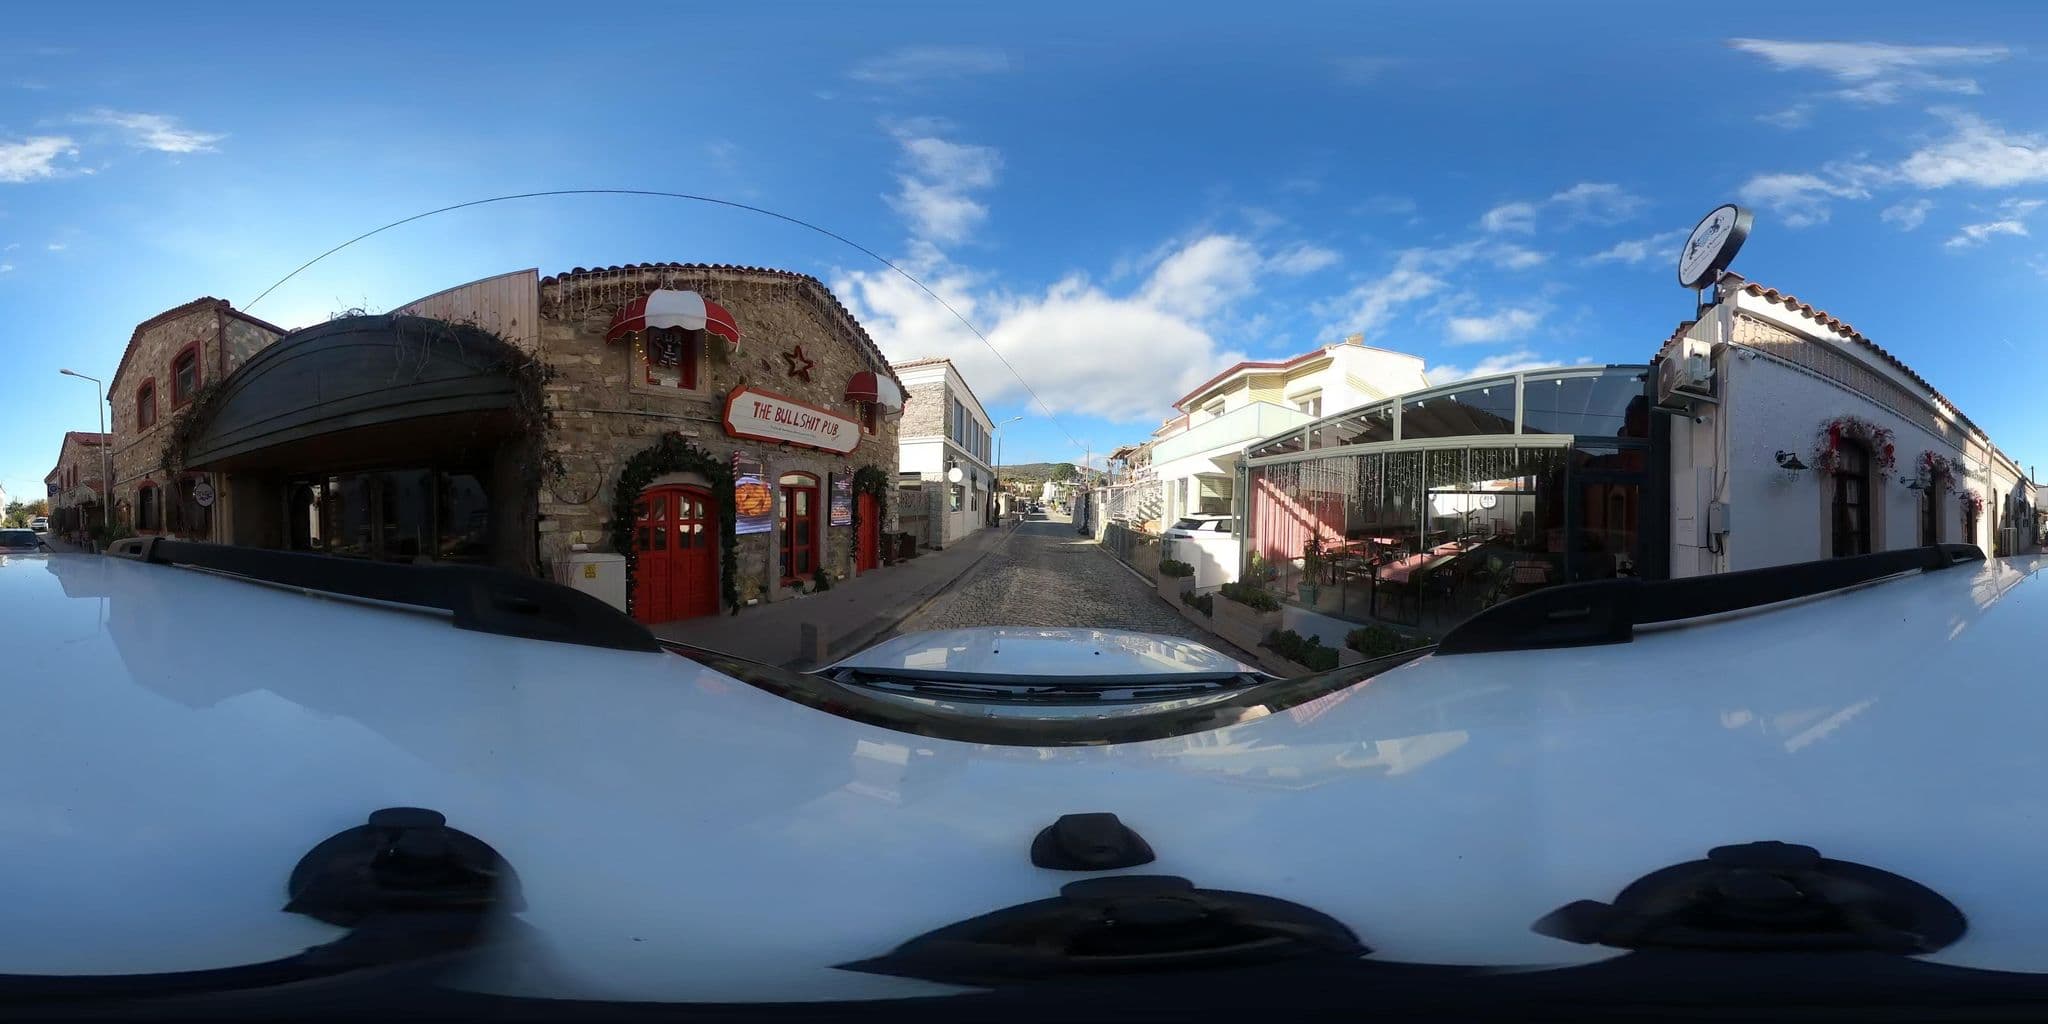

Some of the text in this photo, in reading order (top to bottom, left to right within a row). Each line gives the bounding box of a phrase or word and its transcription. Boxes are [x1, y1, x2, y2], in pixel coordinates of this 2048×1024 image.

[753, 401, 772, 420] THE
[775, 408, 821, 431] BULLSHIT
[821, 420, 839, 436] PUB
